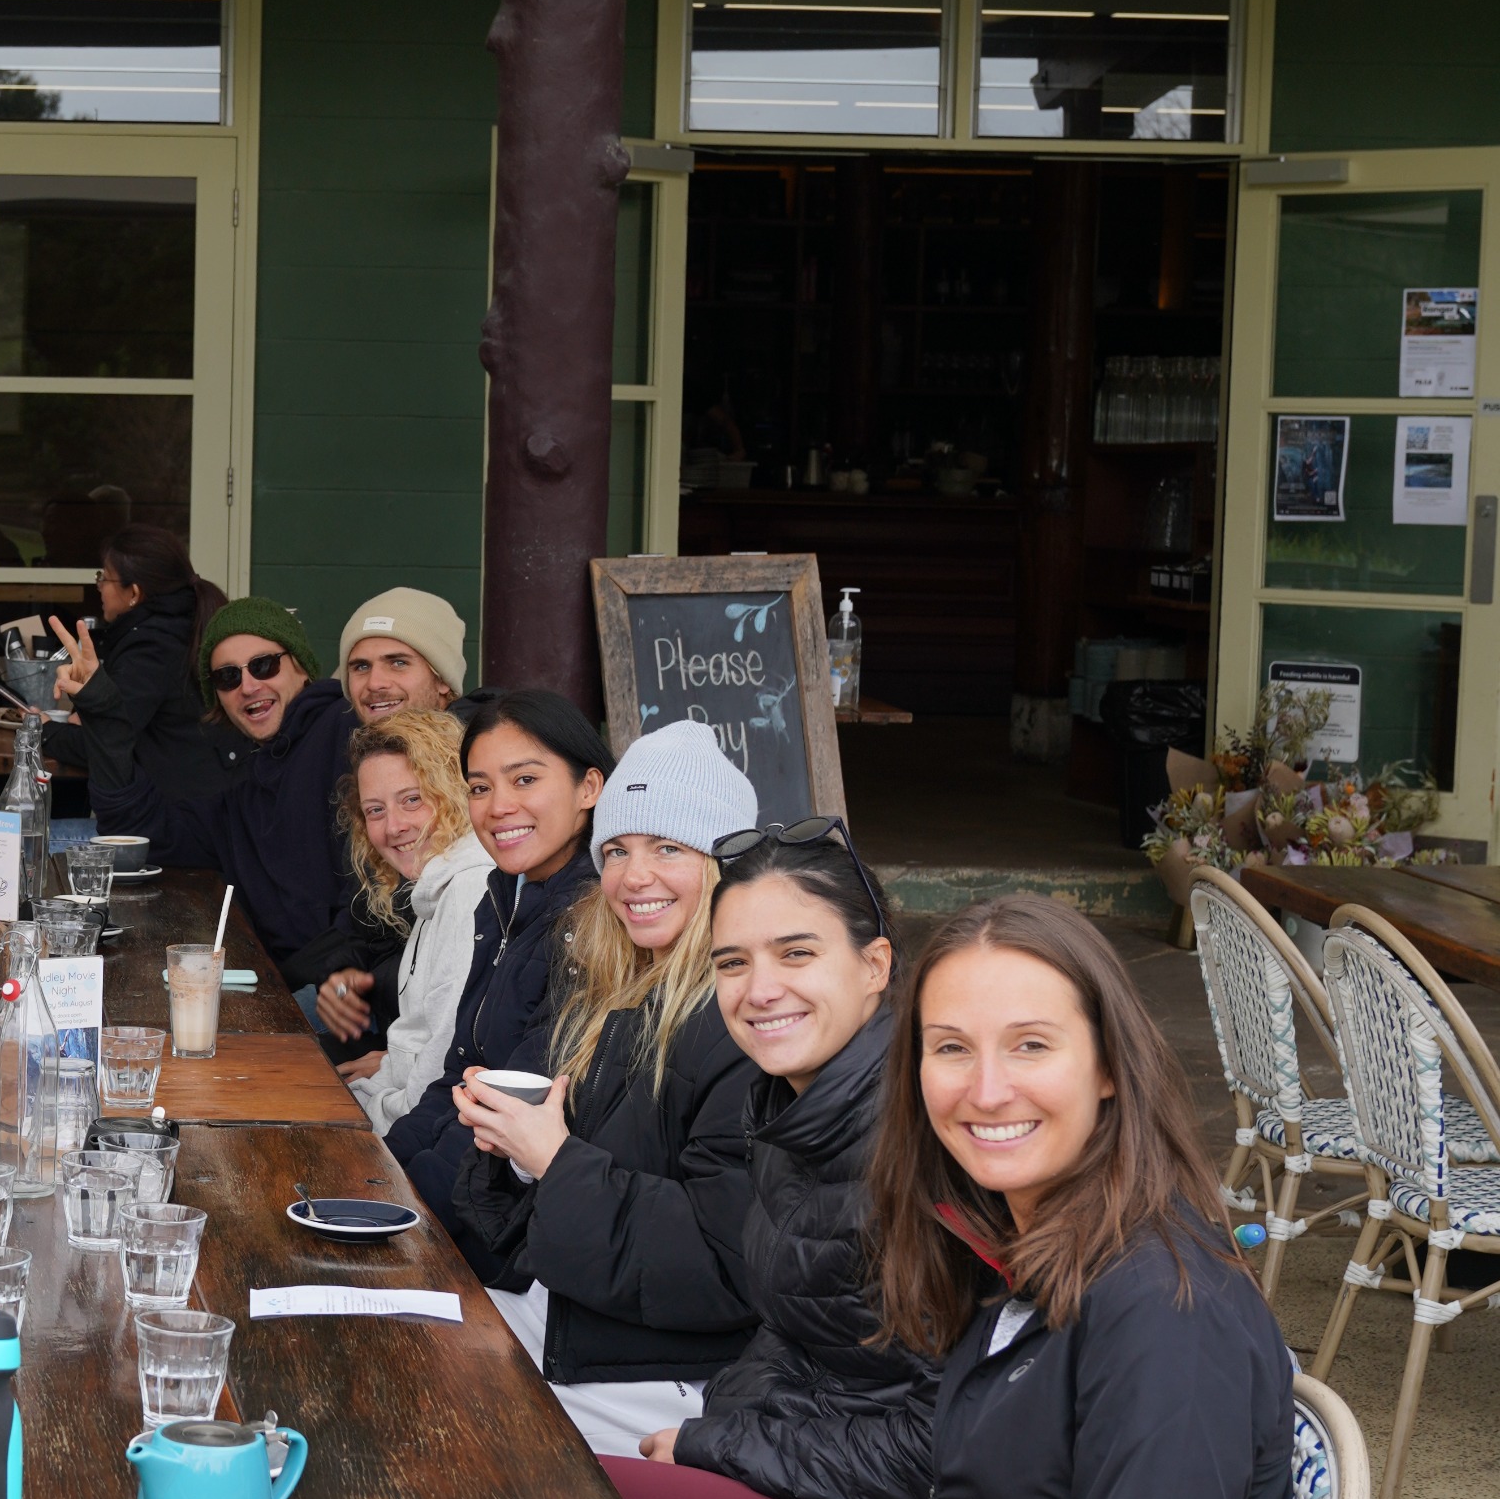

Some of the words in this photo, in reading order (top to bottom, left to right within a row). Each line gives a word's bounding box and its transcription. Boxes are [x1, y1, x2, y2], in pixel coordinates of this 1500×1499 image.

[654, 637, 766, 691] Please
[1280, 670, 1301, 679] Feeding
[39, 972, 66, 984] udley
[68, 970, 96, 981] Movie
[51, 985, 77, 998] Night
[70, 1000, 93, 1008] August
